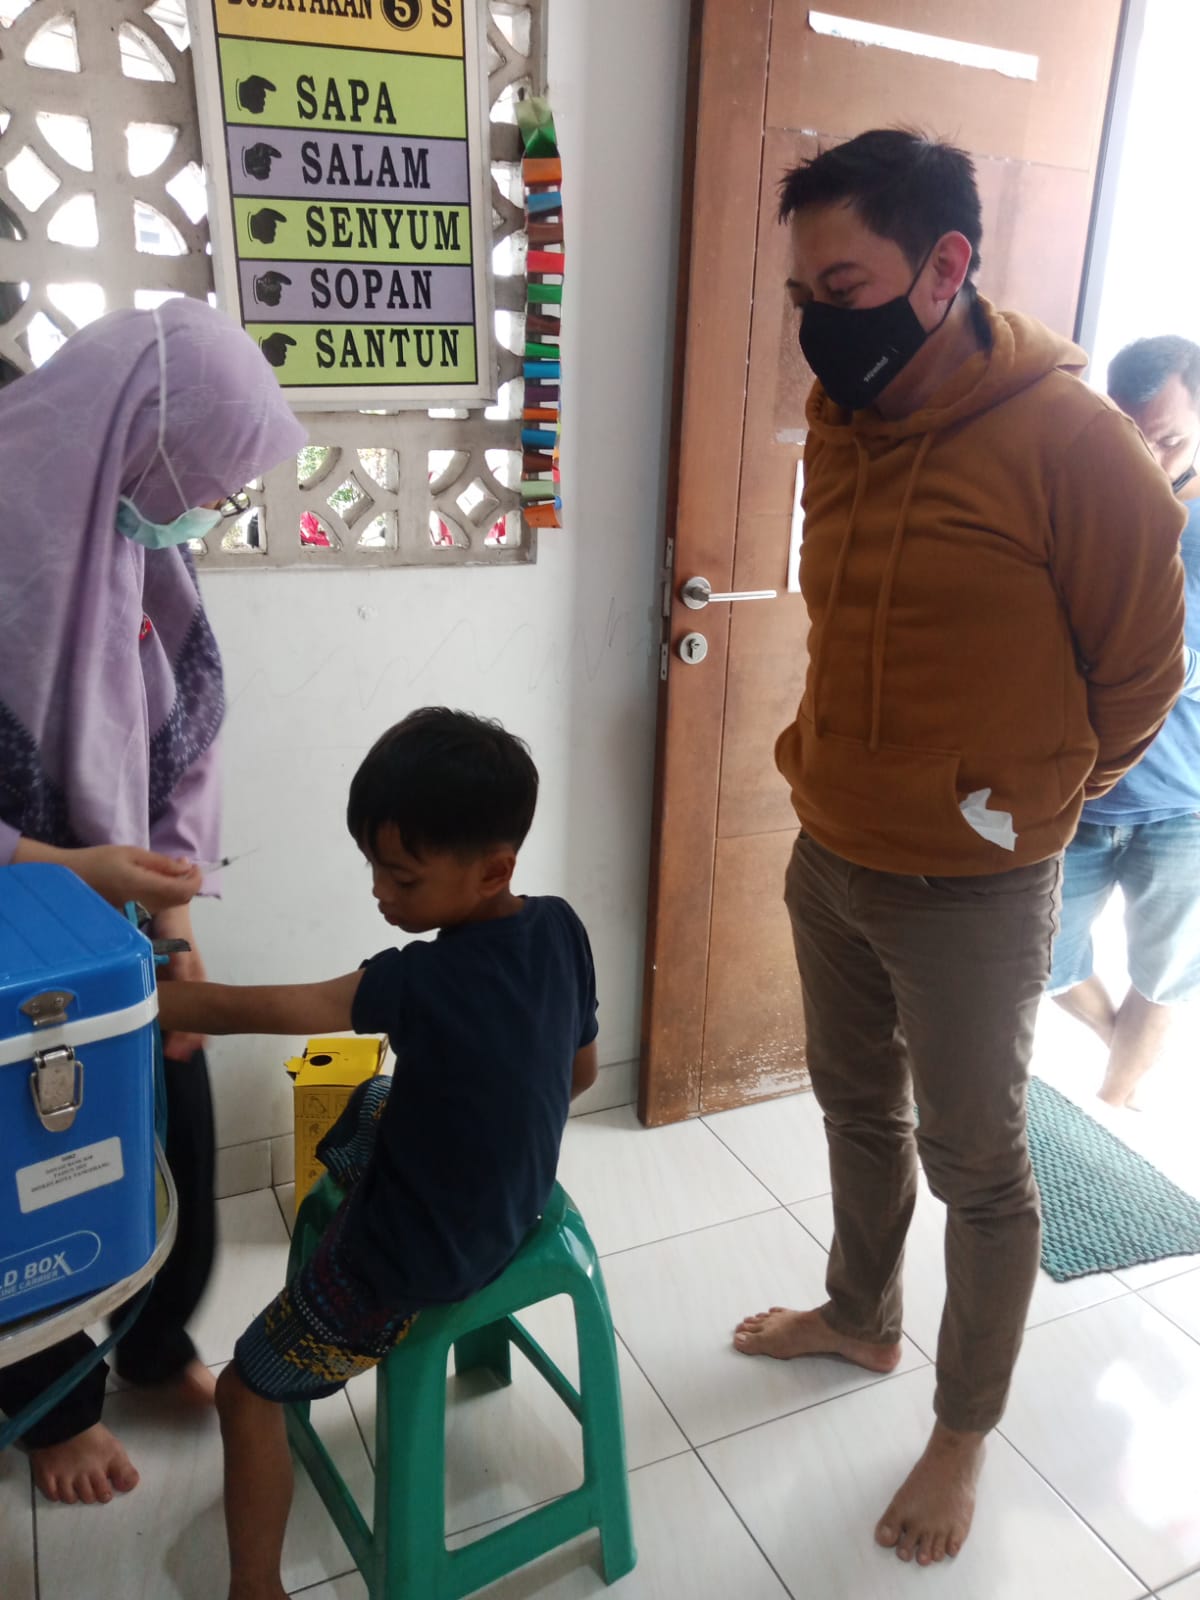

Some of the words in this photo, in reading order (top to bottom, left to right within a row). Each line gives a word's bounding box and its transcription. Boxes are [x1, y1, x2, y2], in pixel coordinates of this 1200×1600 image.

[432, 0, 453, 28] S
[296, 74, 397, 125] SAPA
[301, 141, 431, 189] SALAM
[306, 205, 461, 251] SENYUM
[310, 267, 432, 310] SOPAN
[315, 328, 459, 369] SANTUN
[24, 1251, 73, 1276] BOX
